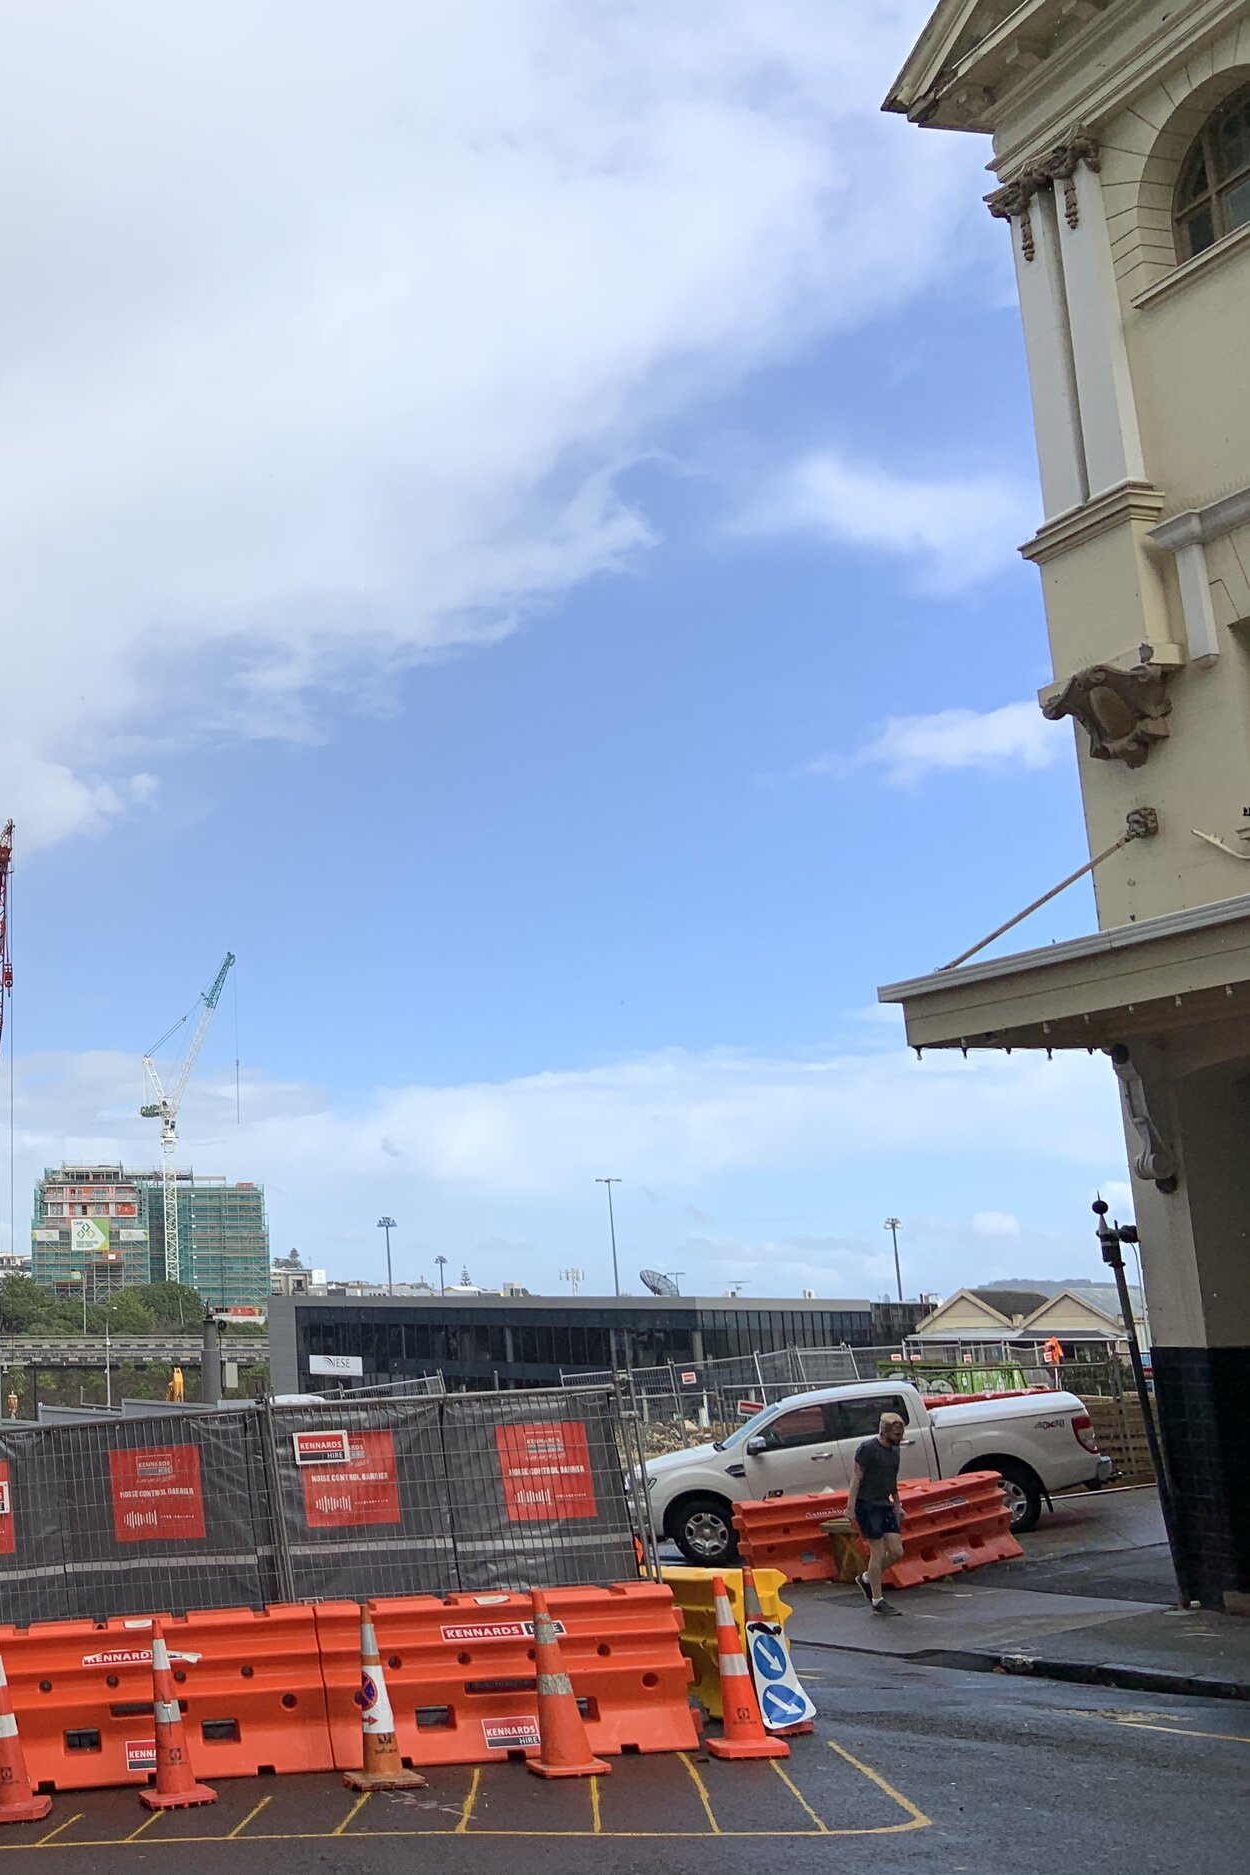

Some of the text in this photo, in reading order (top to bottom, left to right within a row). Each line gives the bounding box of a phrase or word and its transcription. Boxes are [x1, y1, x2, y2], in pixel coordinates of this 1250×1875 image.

[299, 1441, 342, 1450] KENNARDS
[327, 1451, 343, 1459] HIRE
[530, 1466, 559, 1475] CONTROL
[311, 1471, 389, 1483] NOISE CONTROL BARRIER
[445, 1625, 520, 1638] KENNARDS
[486, 1725, 536, 1737] KENNARDS
[518, 1736, 539, 1744] HIRE
